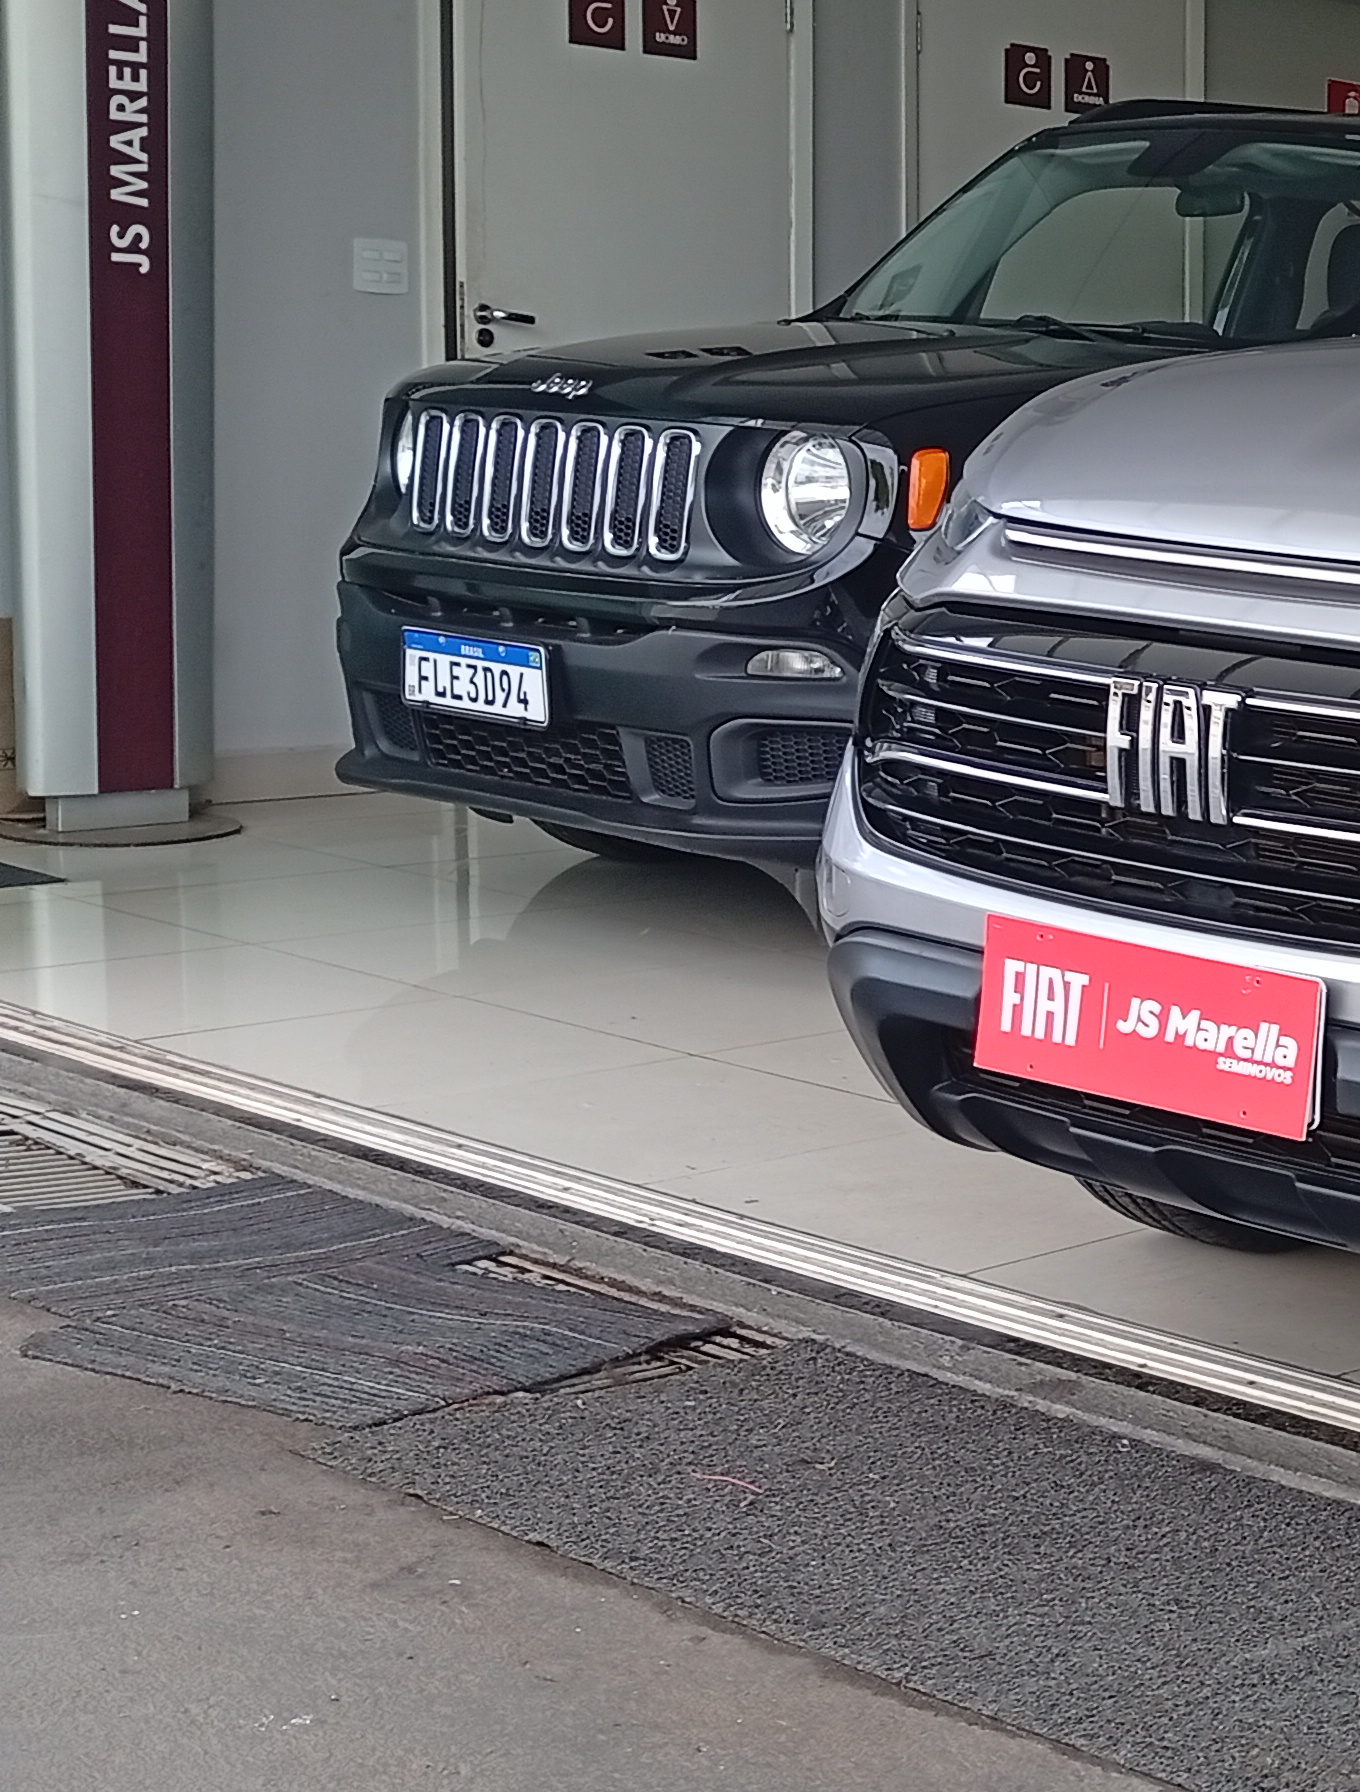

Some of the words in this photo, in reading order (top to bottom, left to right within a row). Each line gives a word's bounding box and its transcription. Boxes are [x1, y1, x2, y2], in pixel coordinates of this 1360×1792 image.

[655, 31, 688, 45] UOMO
[110, 223, 149, 274] JS
[530, 372, 593, 400] Jeep
[460, 644, 484, 658] BRASIL
[418, 656, 529, 712] FLE3D94
[1106, 676, 1243, 825] FIAT
[1000, 957, 1090, 1047] FIAT
[1115, 996, 1162, 1039] JS
[1164, 1005, 1299, 1068] Marella
[1216, 1056, 1293, 1085] SEMINOVOS
